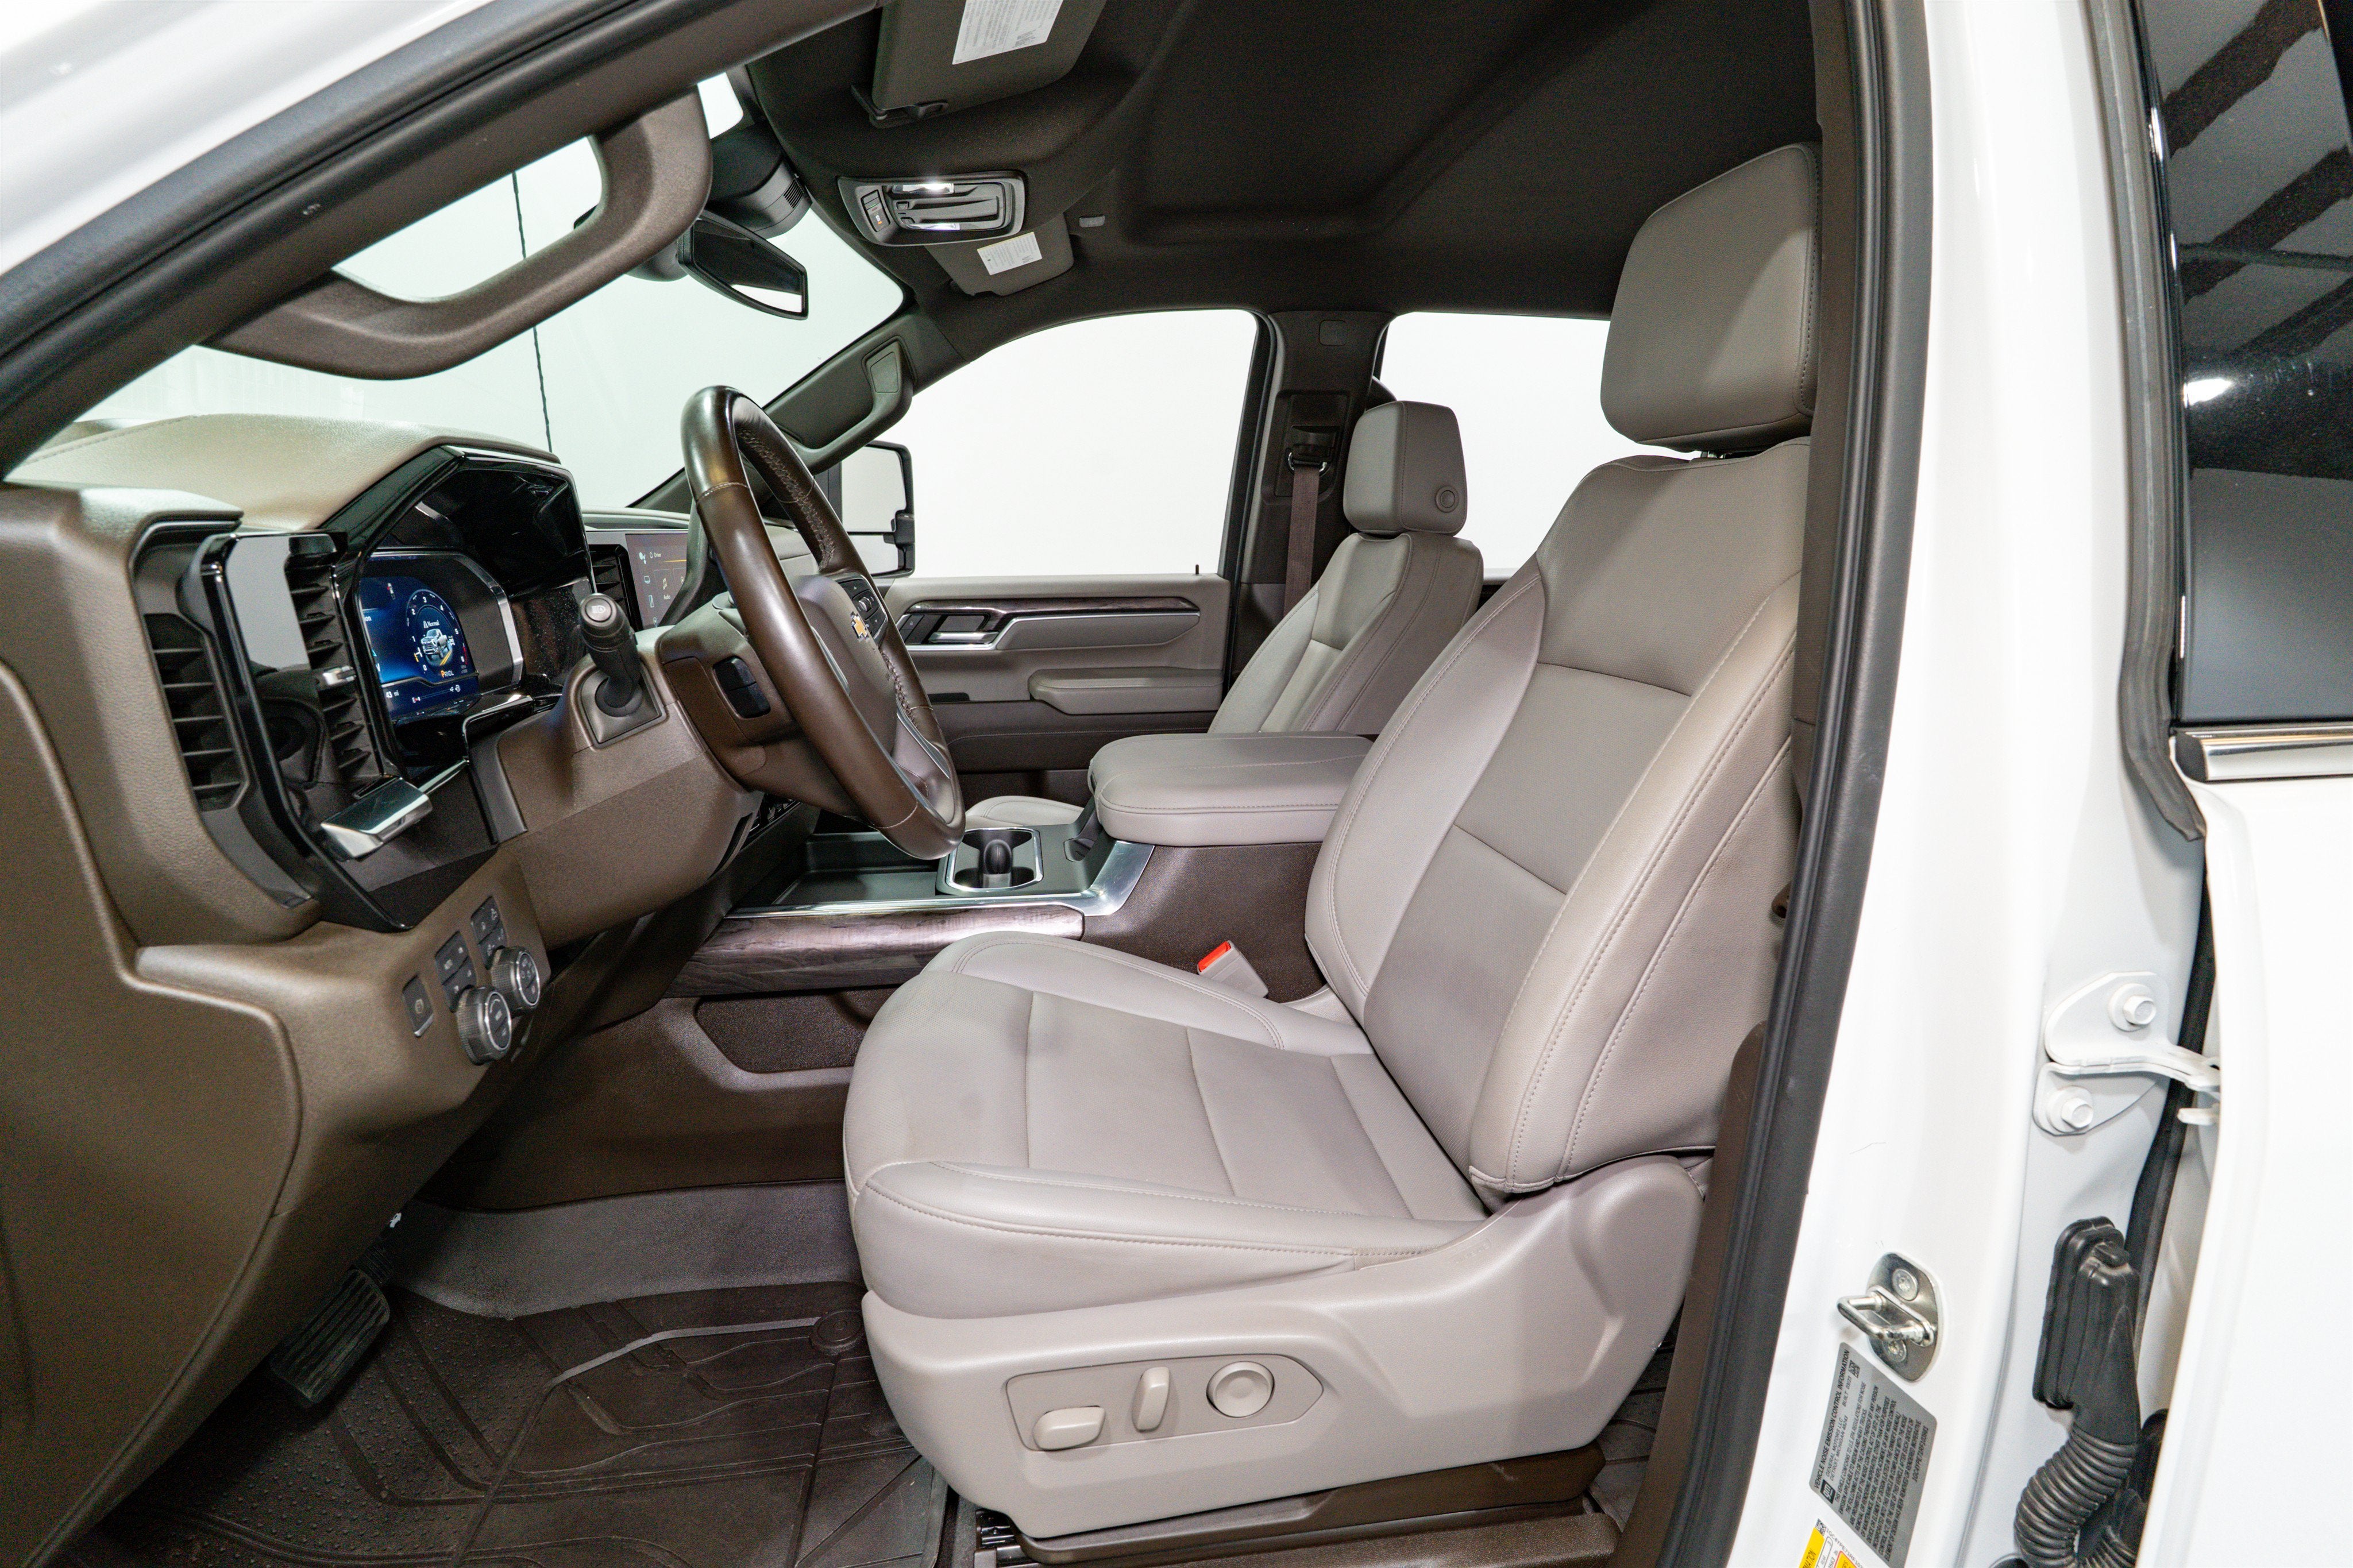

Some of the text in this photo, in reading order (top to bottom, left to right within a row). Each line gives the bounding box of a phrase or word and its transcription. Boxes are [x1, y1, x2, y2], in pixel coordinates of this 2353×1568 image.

[1814, 1463, 1824, 1489] VEHICLE
[1825, 1418, 1835, 1446] EMISSION
[1831, 1389, 1841, 1418] CONTROL
[1838, 1349, 1849, 1390] INFORMATION
[1826, 1452, 1834, 1477] GENERAL
[1832, 1428, 1840, 1451] MOTORS
[1836, 1430, 1844, 1457] MICHIGAN
[1842, 1453, 1850, 1476] CONFORMS
[1852, 1403, 1861, 1431] REGULATIONS
[1855, 1511, 1863, 1531] REMOVAL
[1862, 1480, 1870, 1505] RENDERING
[1881, 1396, 1889, 1419] PURPOSES
[1906, 1447, 1914, 1471] RENDERED
[1843, 1470, 1852, 1494] APPLICABLE
[1878, 1534, 1887, 1555] CONTROL
[1891, 1493, 1896, 1501] OF
[1908, 1418, 1913, 1426] OR
[1904, 1470, 1909, 1478] OR
[1823, 1483, 1833, 1500] gm
[1848, 1481, 1857, 1505] FOLLOWING
[1852, 1491, 1861, 1516] PROHIBITED
[1873, 1516, 1883, 1548] INCORPORATED
[1890, 1447, 1899, 1475] COMPLIANCE
[1861, 1529, 1865, 1537] OF
[1873, 1477, 1878, 1485] OR
[1870, 1520, 1875, 1528] OR
[1877, 1494, 1881, 1502] OF
[1889, 1534, 1894, 1542] OF
[1803, 1549, 1816, 1568] MATION
